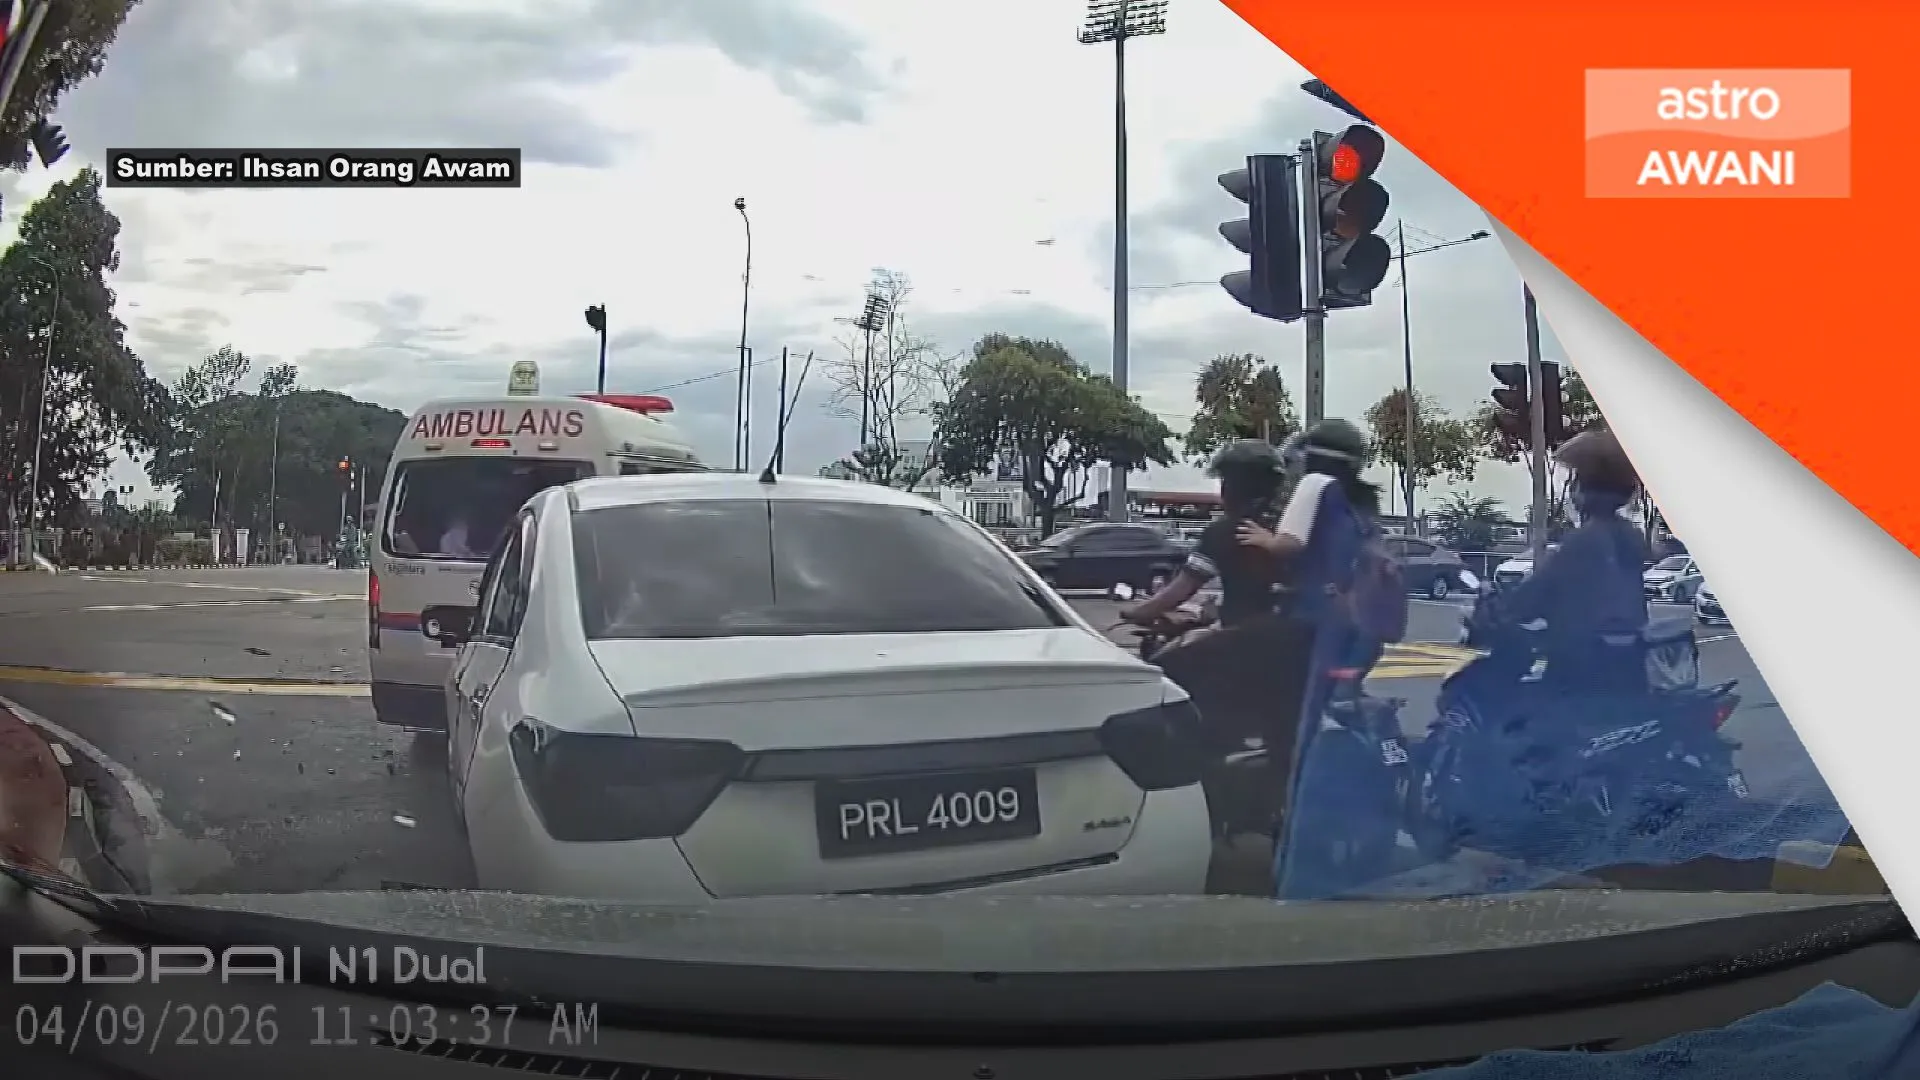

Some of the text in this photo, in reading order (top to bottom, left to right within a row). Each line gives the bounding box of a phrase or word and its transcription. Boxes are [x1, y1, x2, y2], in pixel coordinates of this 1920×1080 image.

[411, 408, 584, 439] AMBULANS
[839, 787, 1020, 840] PRL 4009
